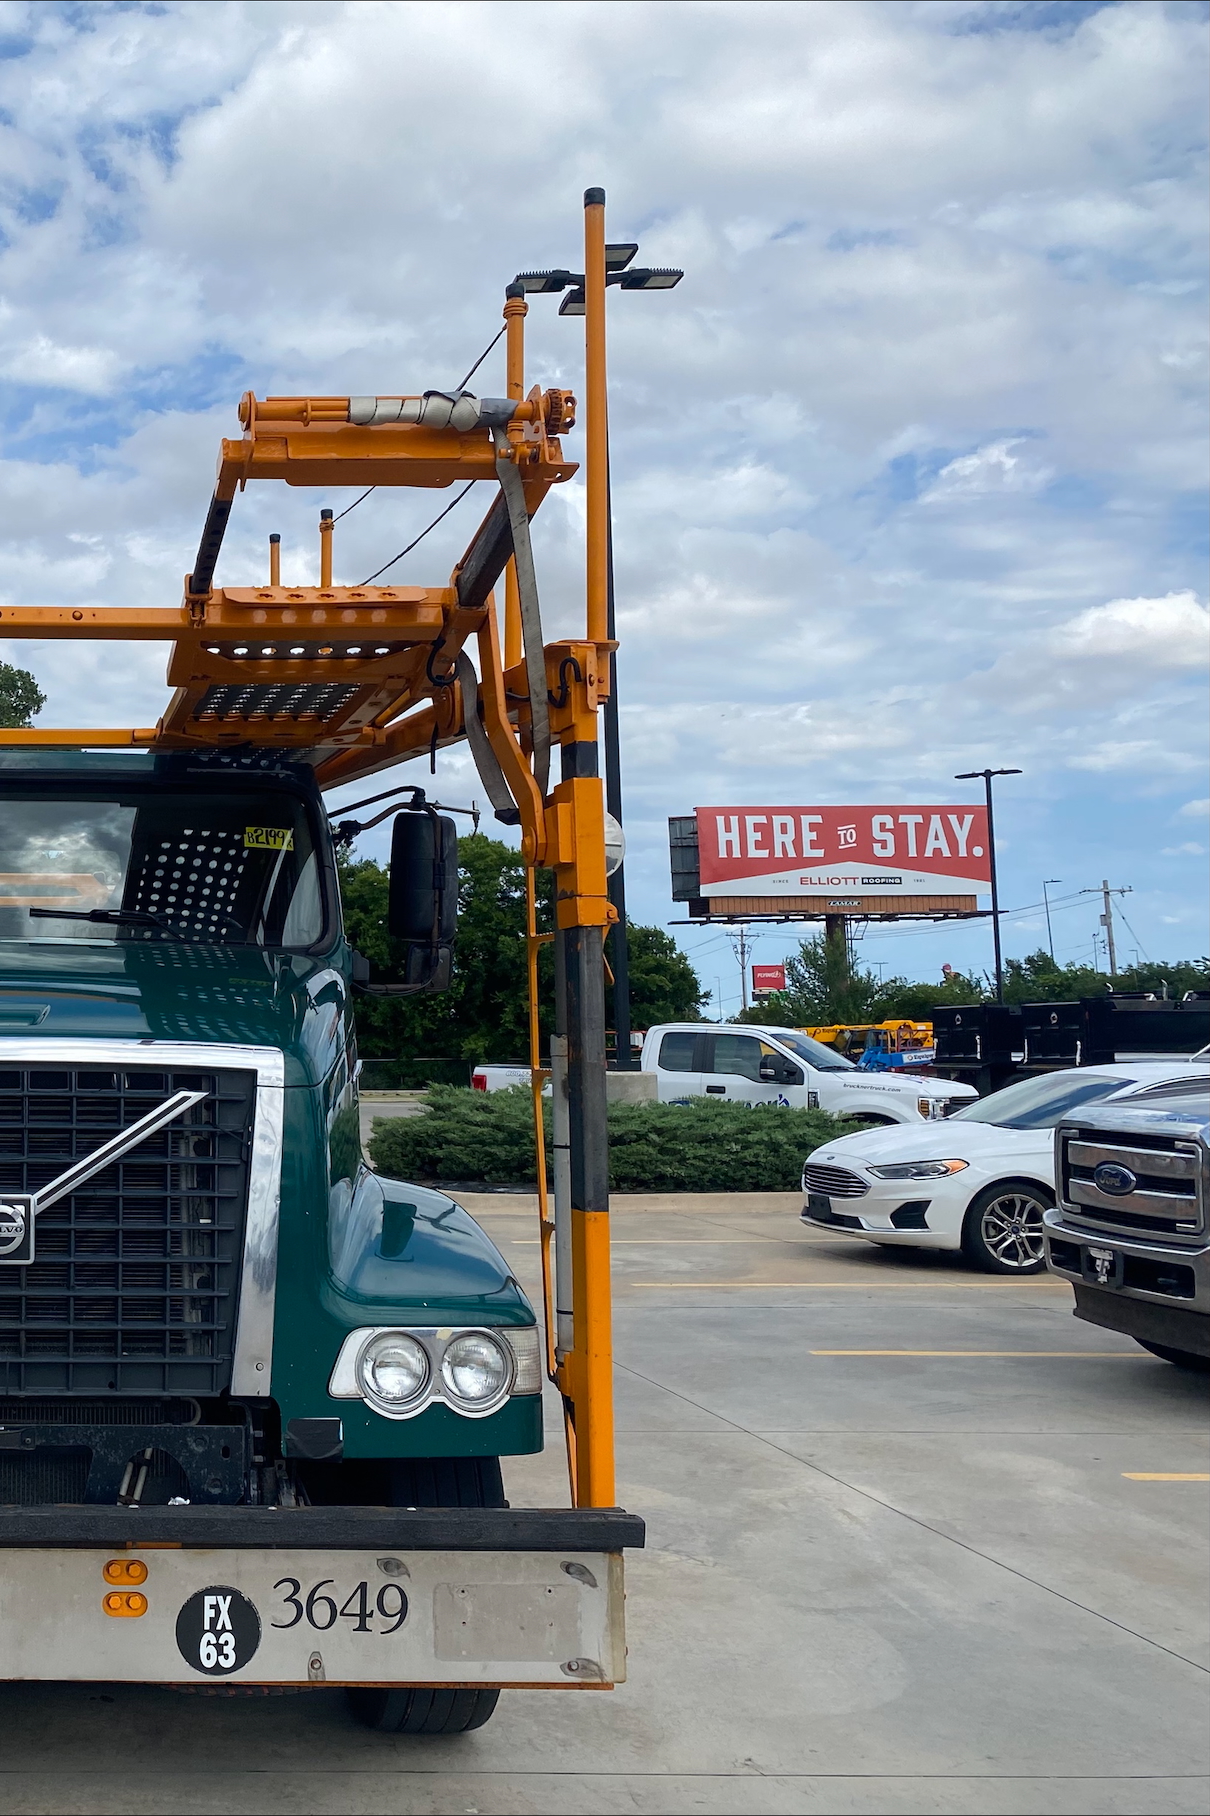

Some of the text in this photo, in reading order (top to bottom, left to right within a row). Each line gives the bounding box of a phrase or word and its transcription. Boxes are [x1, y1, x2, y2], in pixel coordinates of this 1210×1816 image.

[715, 814, 984, 858] HERE TO STAY.
[799, 876, 859, 886] ELLIOTT
[862, 877, 902, 885] ROOFING
[843, 1083, 901, 1093] brucknertruck.com
[1099, 1167, 1122, 1187] Ford
[203, 1595, 233, 1631] FX
[270, 1577, 408, 1634] 3649
[199, 1631, 236, 1669] 63
